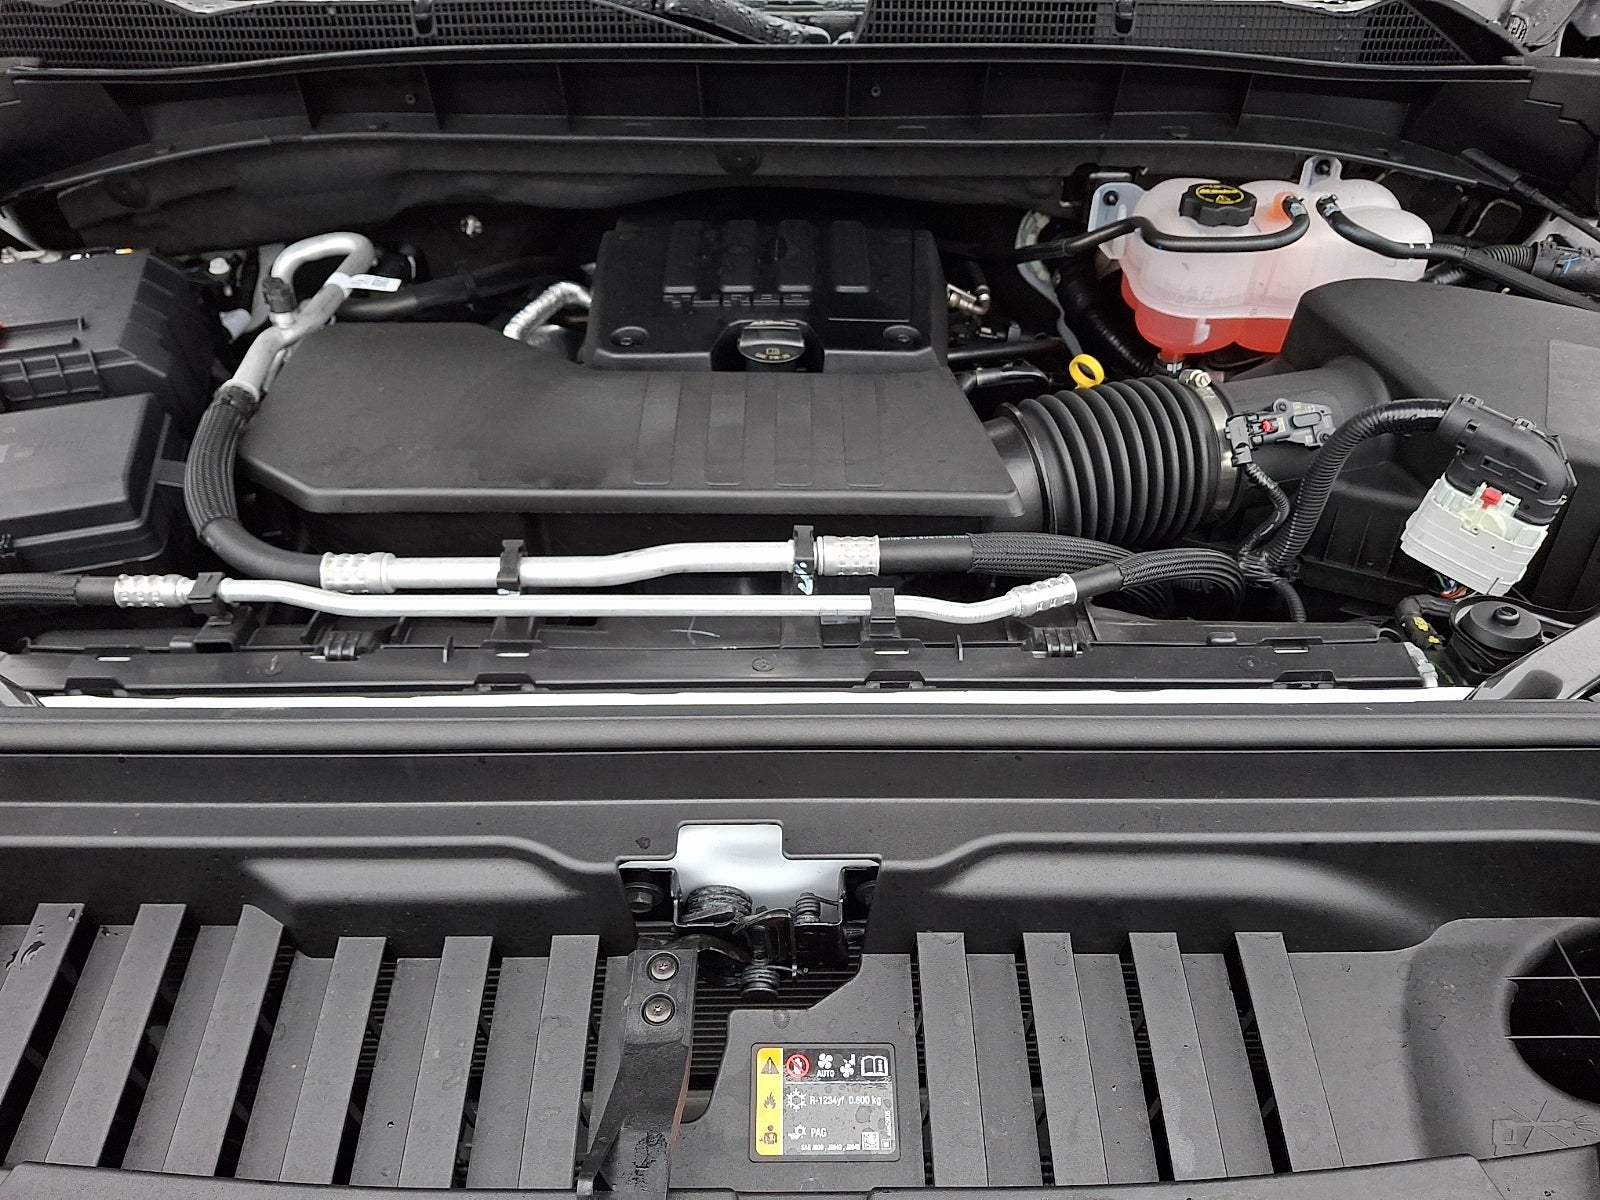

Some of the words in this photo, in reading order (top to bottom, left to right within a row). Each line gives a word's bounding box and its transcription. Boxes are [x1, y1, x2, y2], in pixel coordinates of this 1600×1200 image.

[817, 1070, 835, 1078] AUTO
[810, 1095, 845, 1106] R-1234yf
[848, 1095, 871, 1105] 0.600
[872, 1096, 882, 1107] kg
[810, 1127, 828, 1138] PAG
